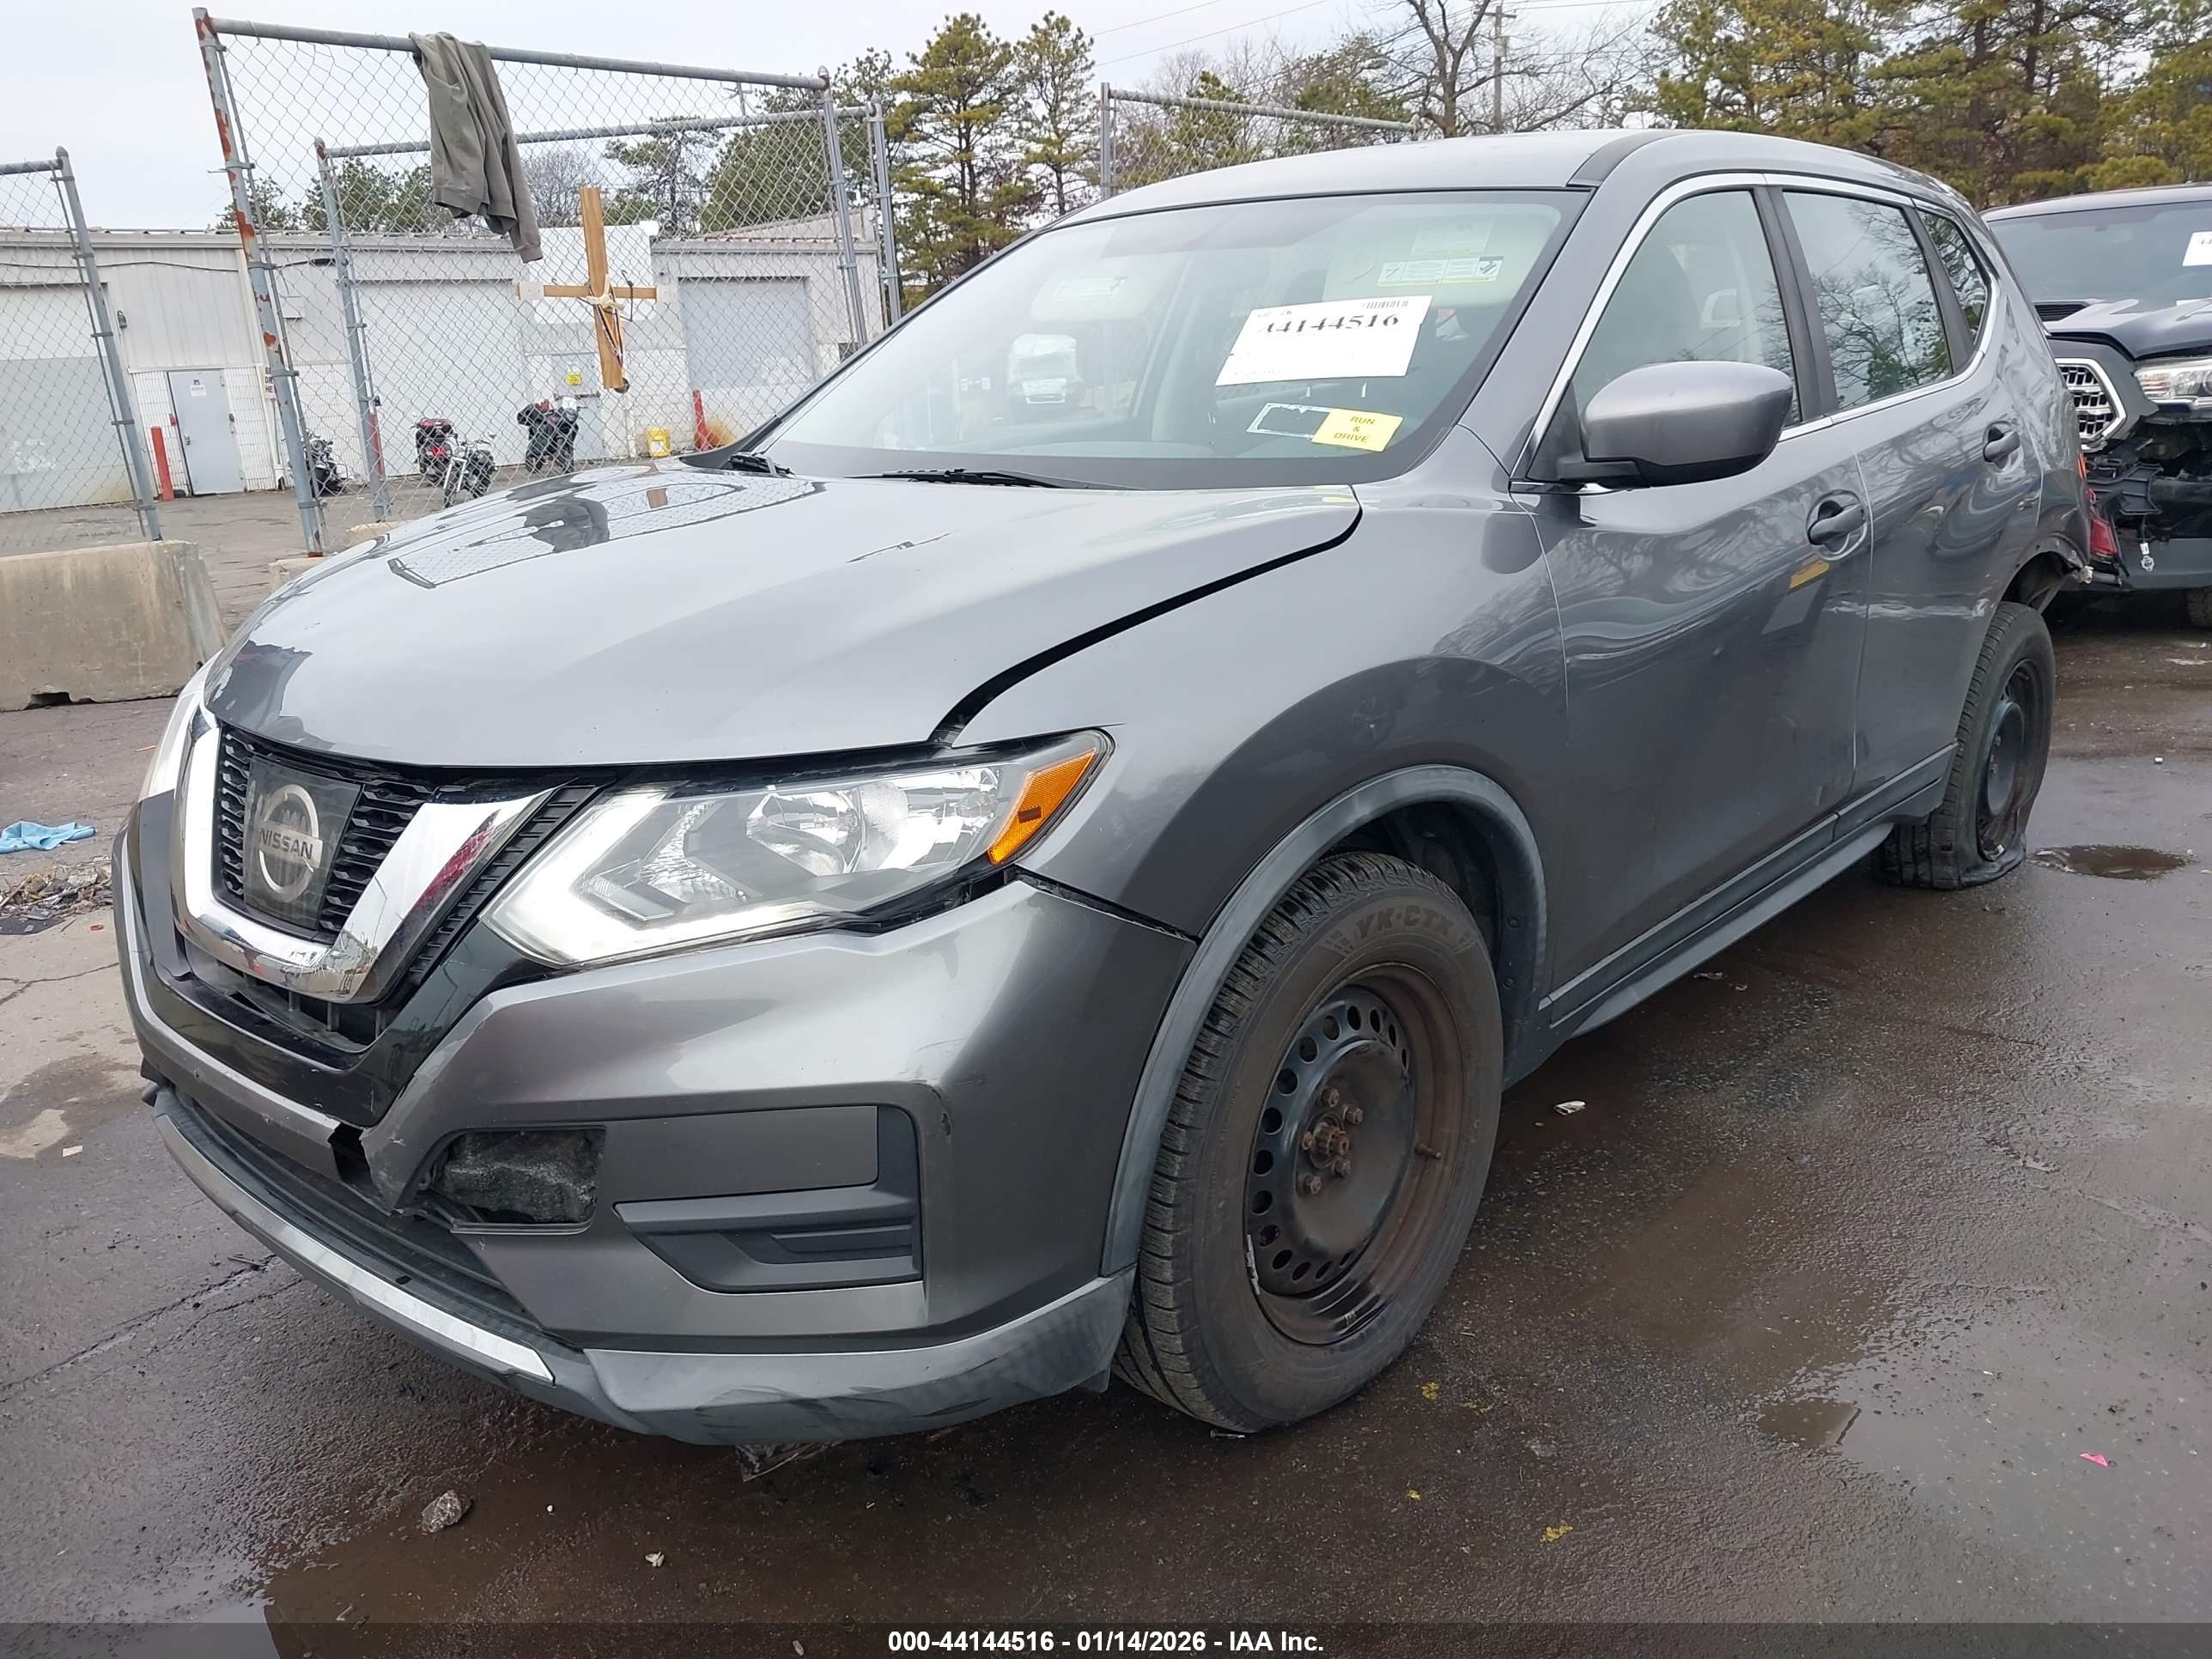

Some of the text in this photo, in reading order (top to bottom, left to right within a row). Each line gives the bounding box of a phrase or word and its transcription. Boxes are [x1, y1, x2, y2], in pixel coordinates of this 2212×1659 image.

[1350, 416, 1376, 425] RUN
[1334, 432, 1370, 442] DRIVE
[260, 828, 313, 860] NISSAN
